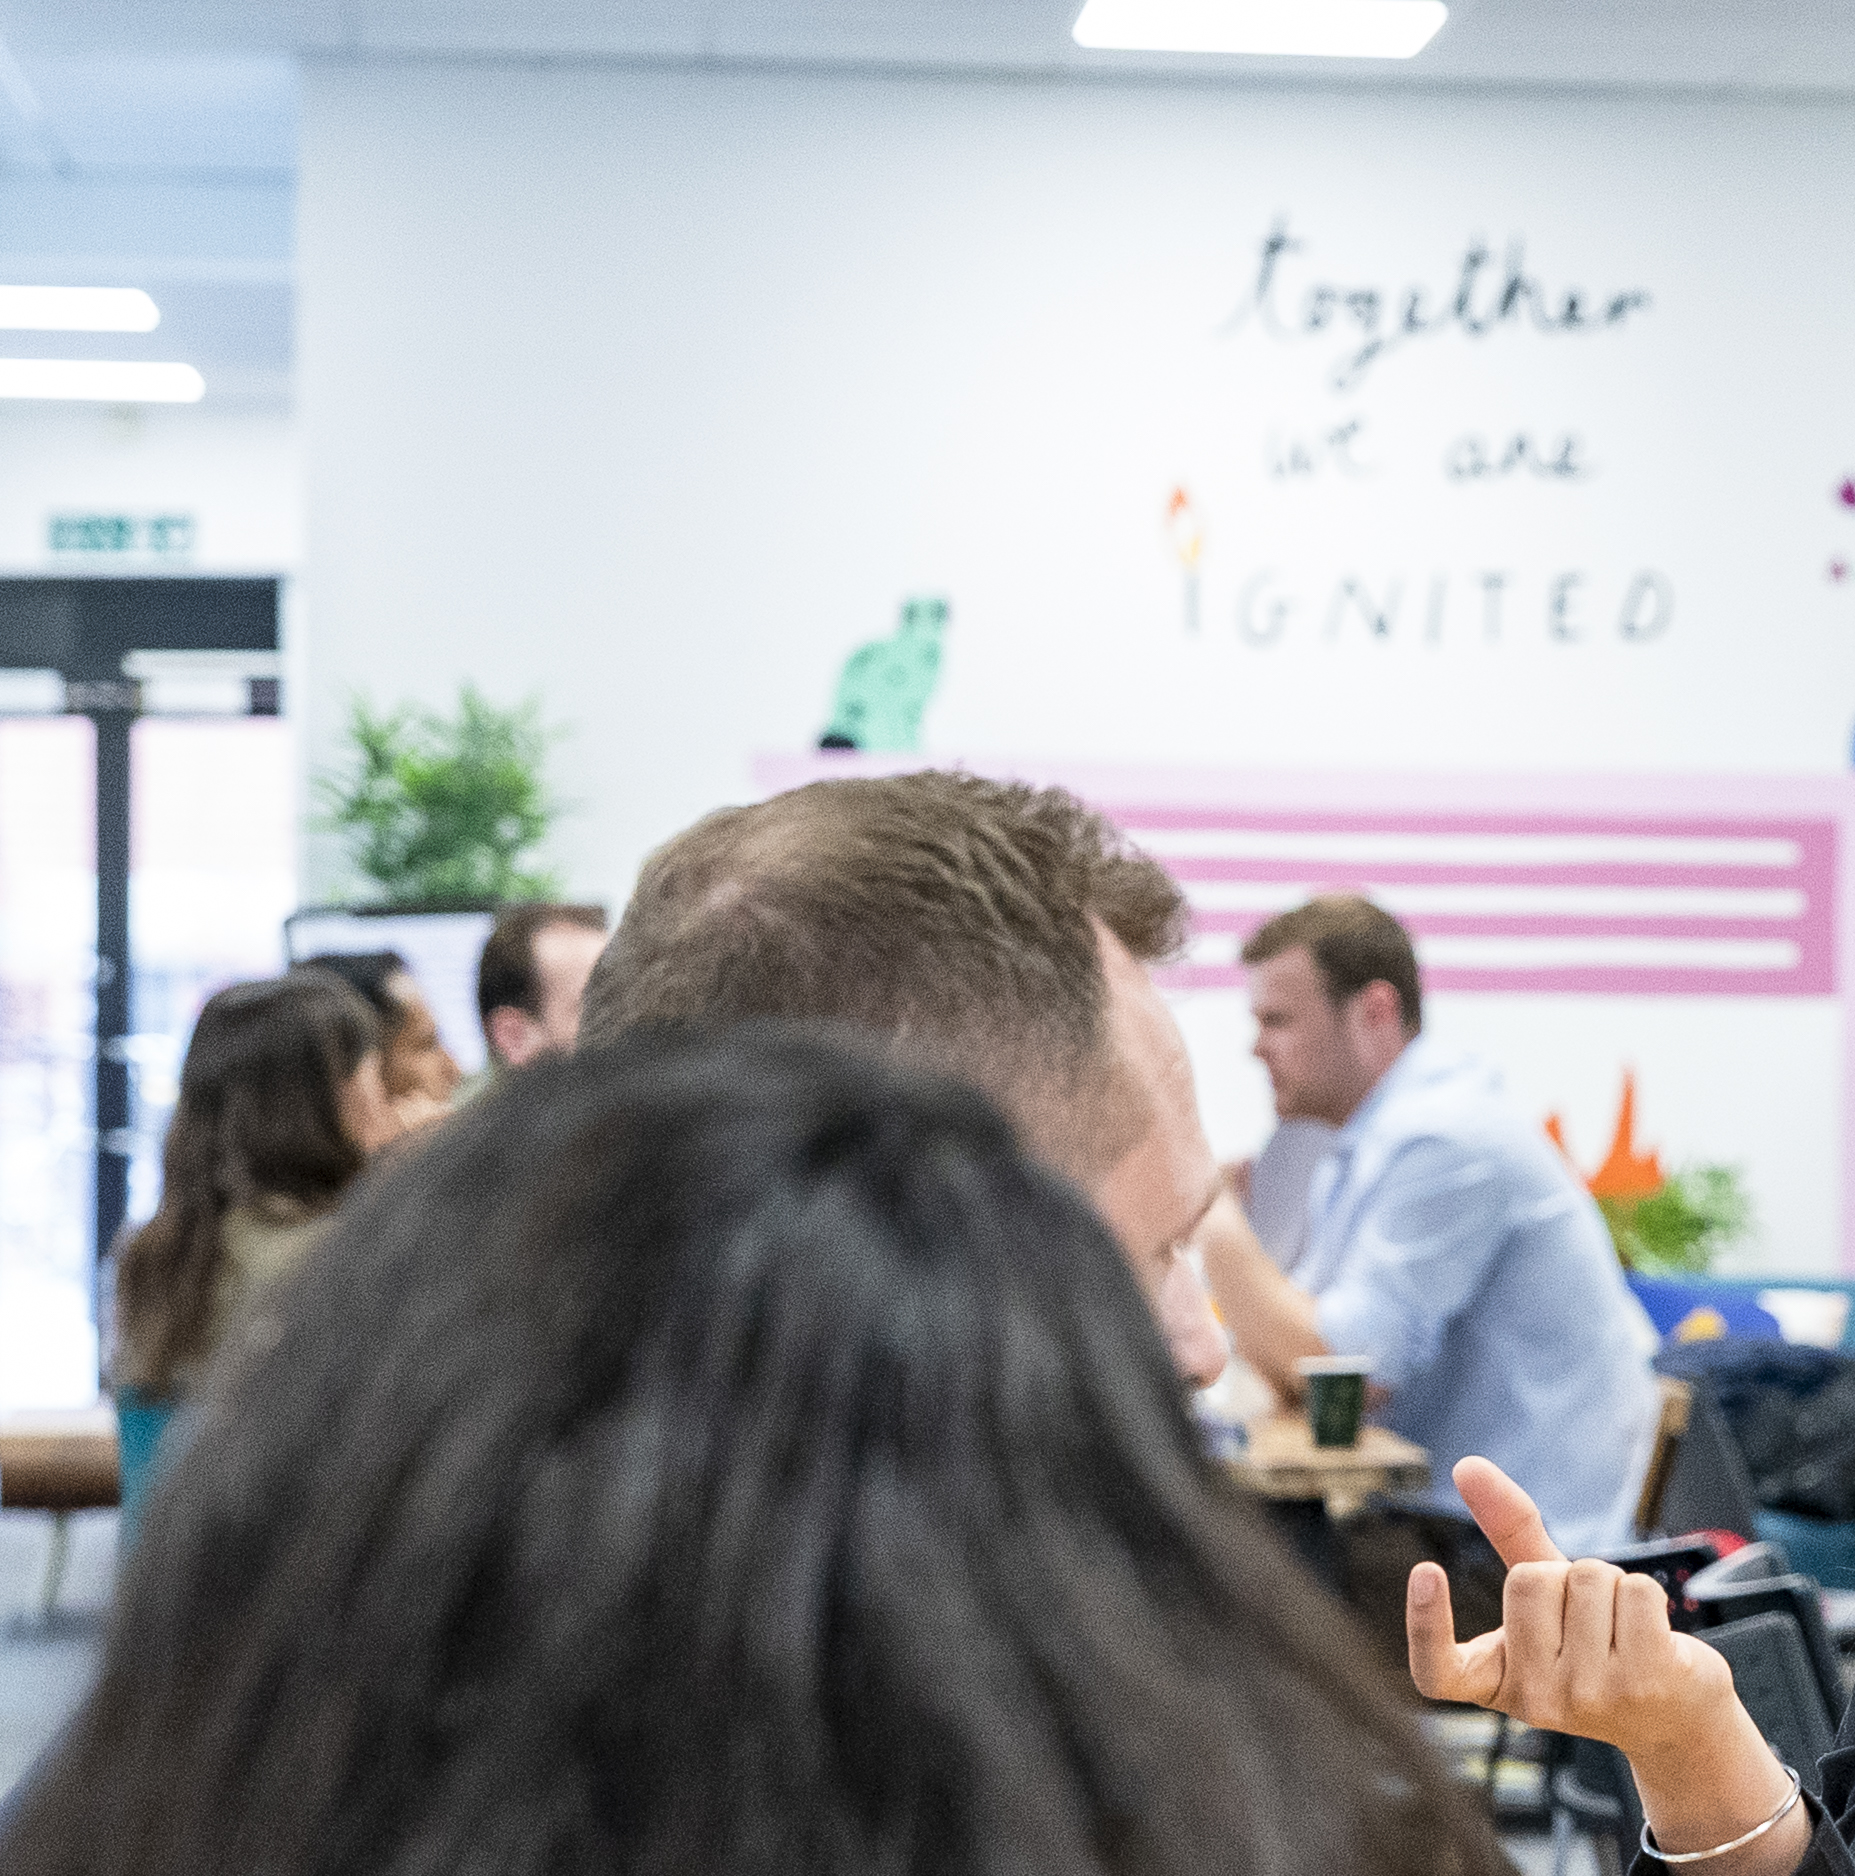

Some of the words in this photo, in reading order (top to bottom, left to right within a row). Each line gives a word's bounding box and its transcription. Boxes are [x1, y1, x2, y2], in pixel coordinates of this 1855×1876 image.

[1218, 212, 1652, 394] together
[1266, 416, 1378, 480] we
[1446, 432, 1596, 482] are
[1182, 566, 1676, 648] IGNITED
